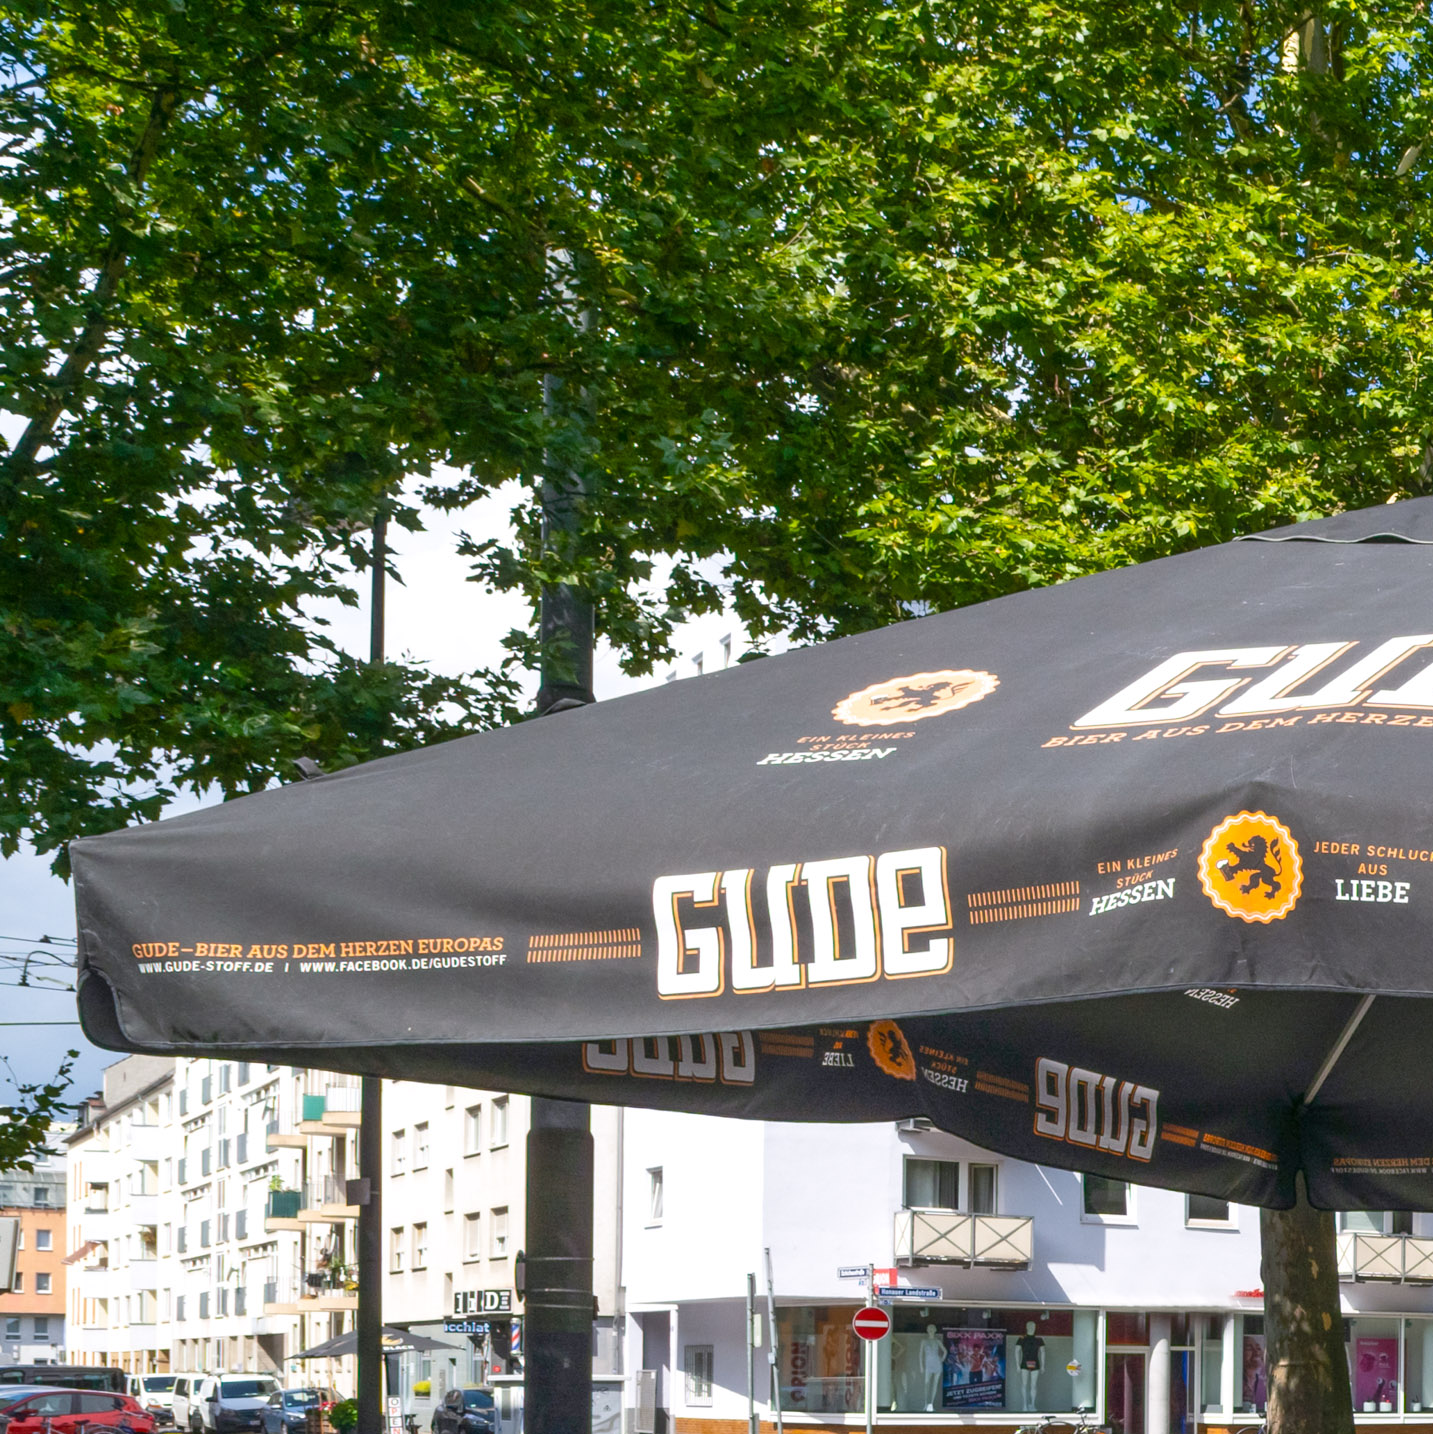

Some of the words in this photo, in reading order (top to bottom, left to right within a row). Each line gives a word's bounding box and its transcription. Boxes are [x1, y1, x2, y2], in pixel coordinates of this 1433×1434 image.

[796, 735, 831, 744] EIN
[835, 731, 916, 742] KLEINES
[1041, 731, 1124, 749] BIER
[1132, 724, 1206, 742] AUS
[1215, 716, 1303, 735] DEM
[809, 741, 871, 751] STÜCK
[756, 747, 897, 766] HESSEN
[1314, 841, 1360, 856] JEDER
[1097, 861, 1121, 875] EIN
[1127, 848, 1178, 871] KLEINES
[1358, 863, 1388, 876] AUS
[1116, 869, 1153, 889] STÜCK
[1089, 878, 1176, 917] HESSEN
[1335, 879, 1410, 904] LIEBE
[247, 944, 288, 960] AUS
[292, 943, 337, 959] DEM
[339, 939, 414, 957] HERZEN
[417, 936, 504, 954] EUROPAS
[137, 960, 274, 974] WWW.GUDE-STOFF.DE
[300, 954, 507, 973] WWW.FACEBOOK.DE/GUDESTOFF
[881, 1288, 905, 1296] Hanauer
[390, 1398, 403, 1434] OPEN
